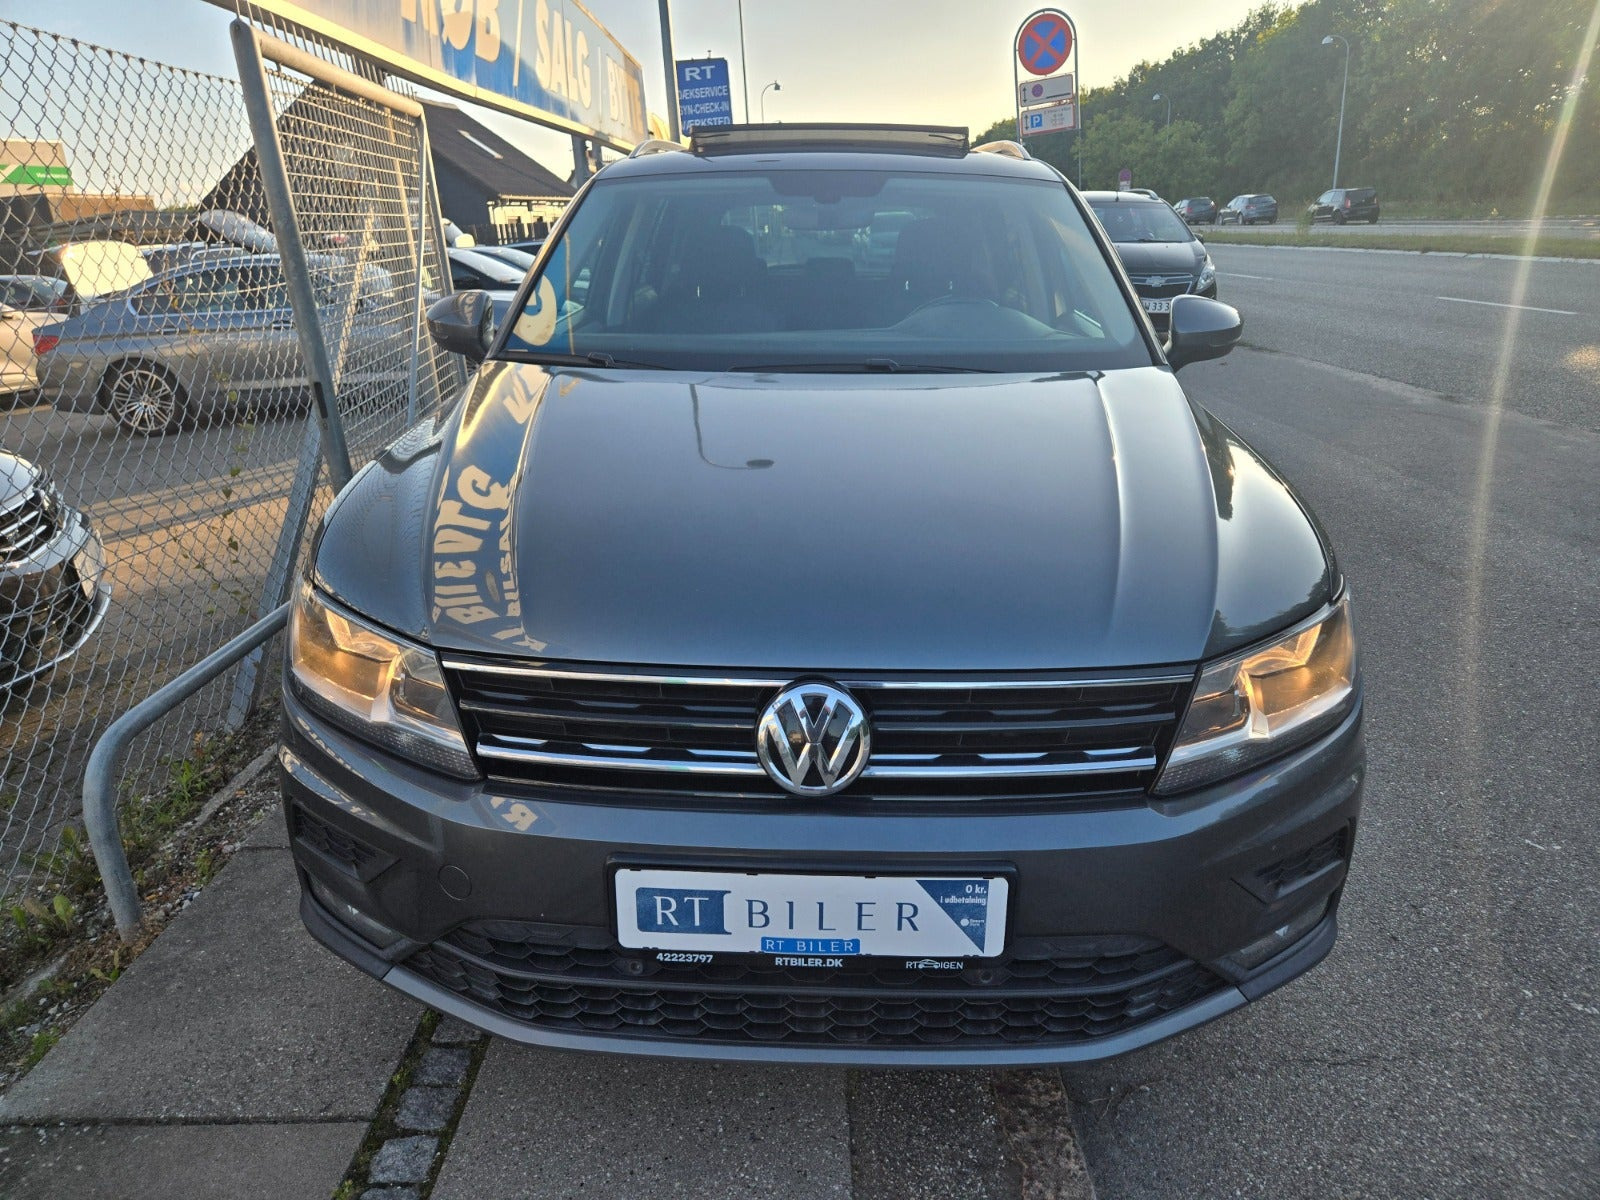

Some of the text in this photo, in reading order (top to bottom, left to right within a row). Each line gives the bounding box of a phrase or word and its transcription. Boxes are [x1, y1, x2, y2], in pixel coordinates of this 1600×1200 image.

[534, 0, 593, 110] SALG
[684, 65, 716, 82] RT
[975, 884, 987, 894] kr.
[653, 895, 919, 931] RT BILER
[765, 939, 853, 952] RT BILER
[656, 952, 713, 964] 42223797
[775, 957, 843, 968] RTBILER.DK
